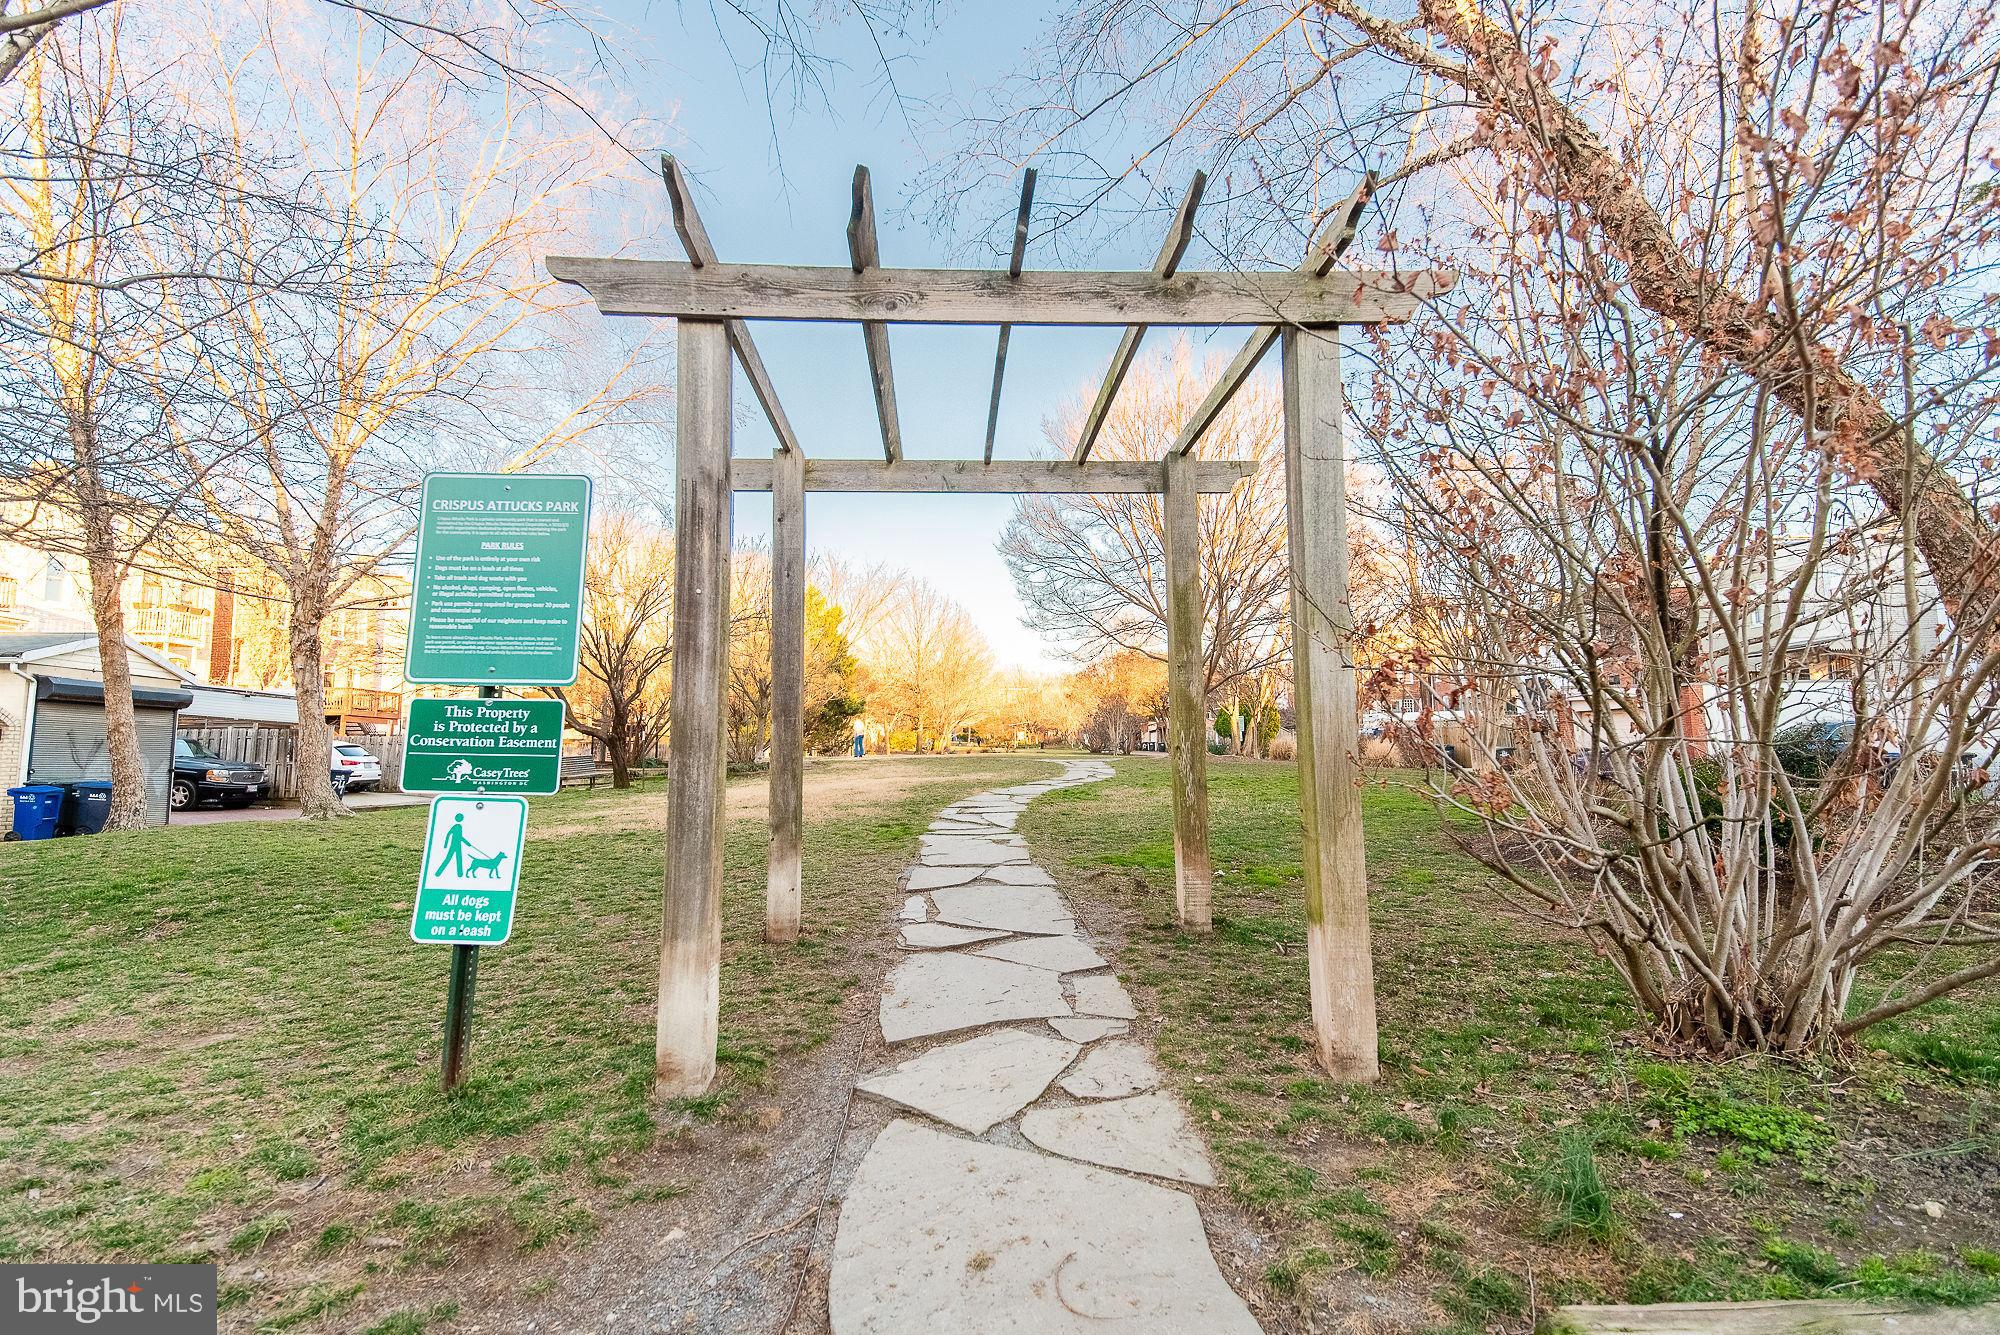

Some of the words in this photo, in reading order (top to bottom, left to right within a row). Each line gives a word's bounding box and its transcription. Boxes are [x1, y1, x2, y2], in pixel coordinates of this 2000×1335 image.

[432, 499, 484, 512] CRISPUS
[486, 500, 543, 512] ATTUCKS
[545, 501, 579, 512] PARK
[481, 542, 500, 550] PARK
[502, 542, 524, 550] RULES
[444, 706, 473, 718] This
[476, 707, 530, 720] Property
[434, 720, 445, 732] is
[449, 721, 509, 733] Protected
[512, 722, 528, 736] by
[530, 725, 538, 734] a
[409, 734, 495, 748] Conservation
[498, 736, 558, 749] Easement
[442, 894, 459, 906] All
[461, 894, 489, 908] dogs
[425, 910, 455, 920] must
[457, 909, 472, 921] be
[475, 910, 501, 924] kept
[431, 926, 445, 936] on
[448, 926, 456, 936] a
[459, 924, 491, 936] leash
